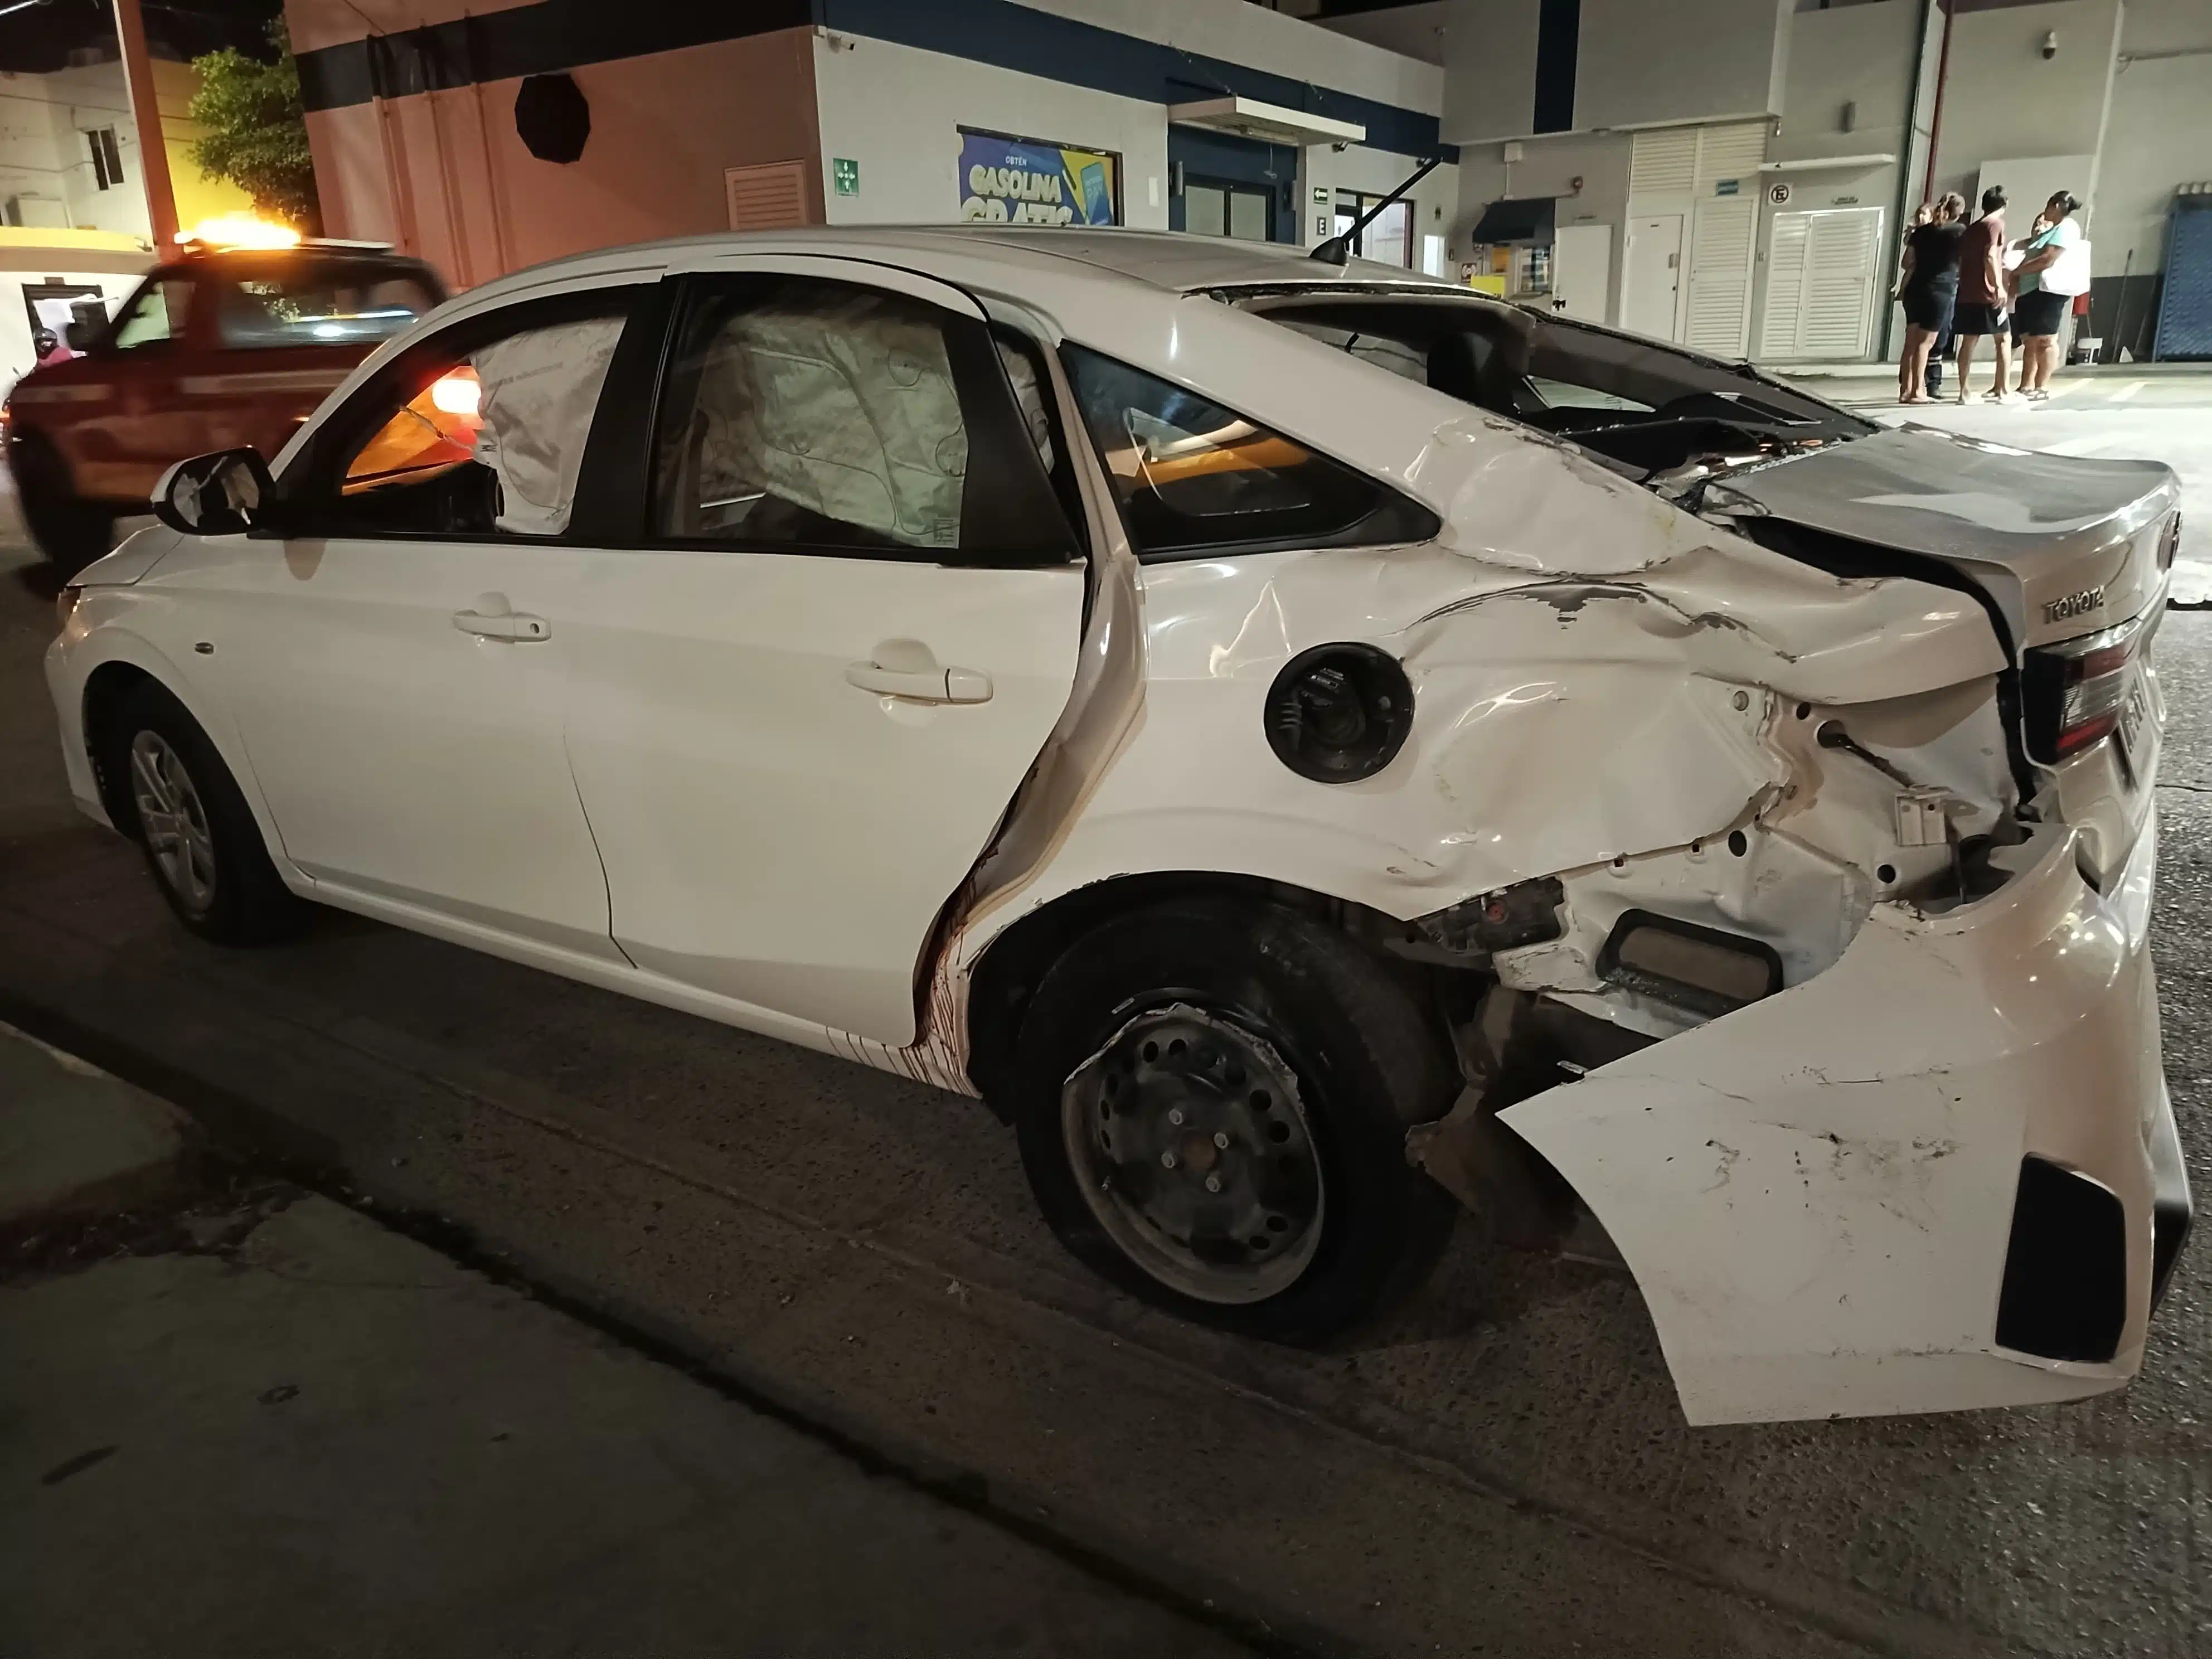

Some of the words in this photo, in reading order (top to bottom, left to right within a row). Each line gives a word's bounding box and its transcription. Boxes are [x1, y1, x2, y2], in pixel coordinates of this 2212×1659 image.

[969, 164, 1062, 203] GASOLINA
[1320, 219, 1325, 234] E
[2042, 585, 2105, 624] TOYOTA
